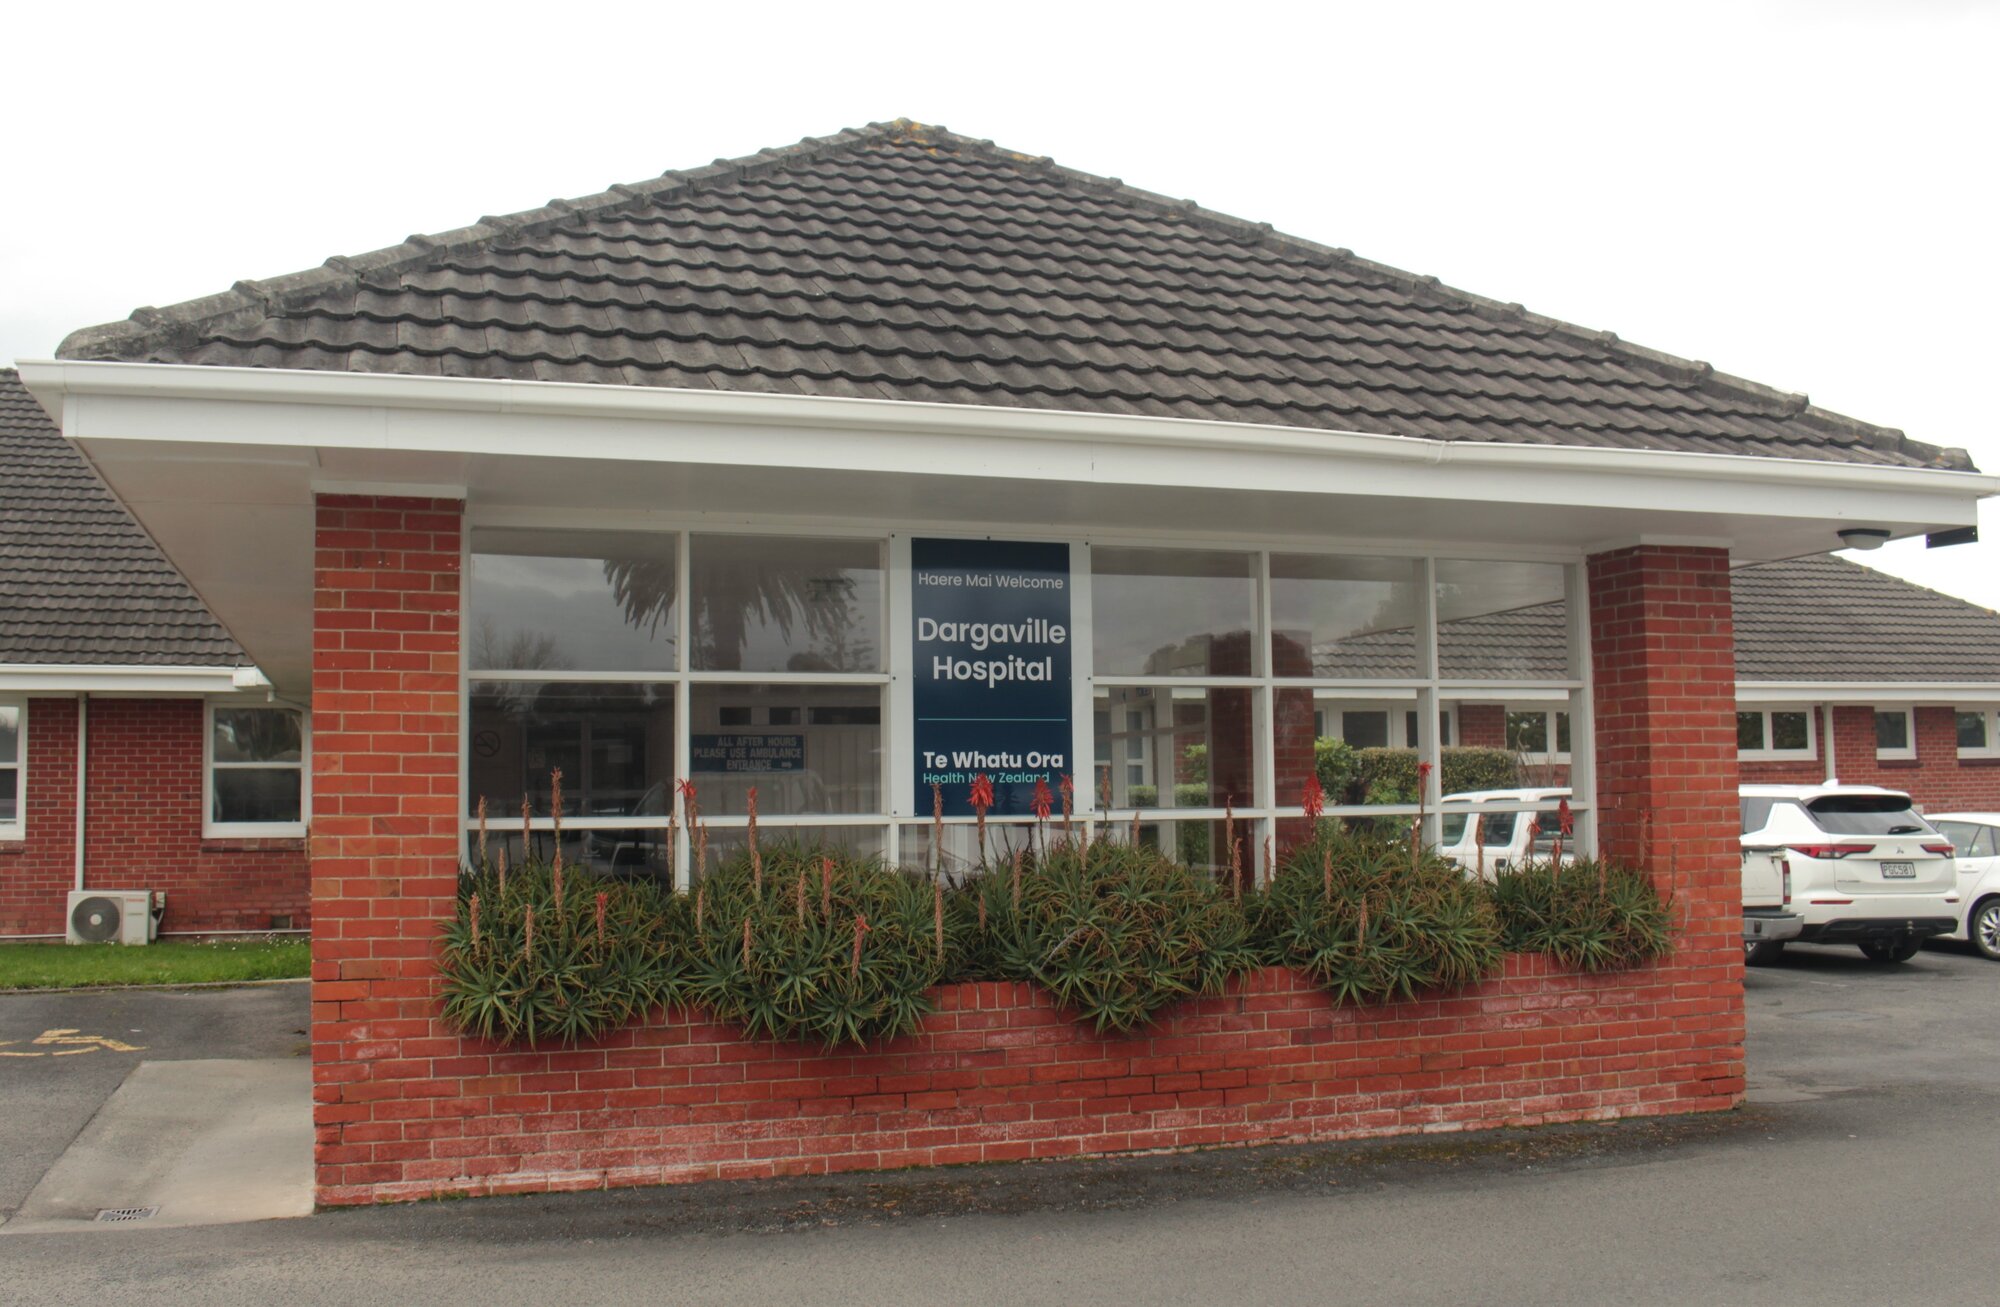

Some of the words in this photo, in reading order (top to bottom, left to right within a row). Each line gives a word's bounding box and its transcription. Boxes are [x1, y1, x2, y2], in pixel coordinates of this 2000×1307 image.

[918, 572, 962, 587] Haere
[966, 574, 992, 588] Mai
[995, 575, 1064, 590] Welcome
[918, 617, 1066, 651] Dargaville
[933, 655, 1052, 688] Hospital
[717, 737, 734, 747] ALL
[736, 737, 764, 747] AFTER
[693, 748, 727, 758] PLEASE
[729, 748, 747, 758] USE
[750, 748, 802, 758] AMBULANCE
[923, 751, 948, 768] Te
[952, 751, 1022, 768] Whatu
[1026, 751, 1063, 768] Ora
[726, 759, 772, 770] ENTRANCE
[923, 772, 965, 784] Health
[968, 772, 995, 784] Nw
